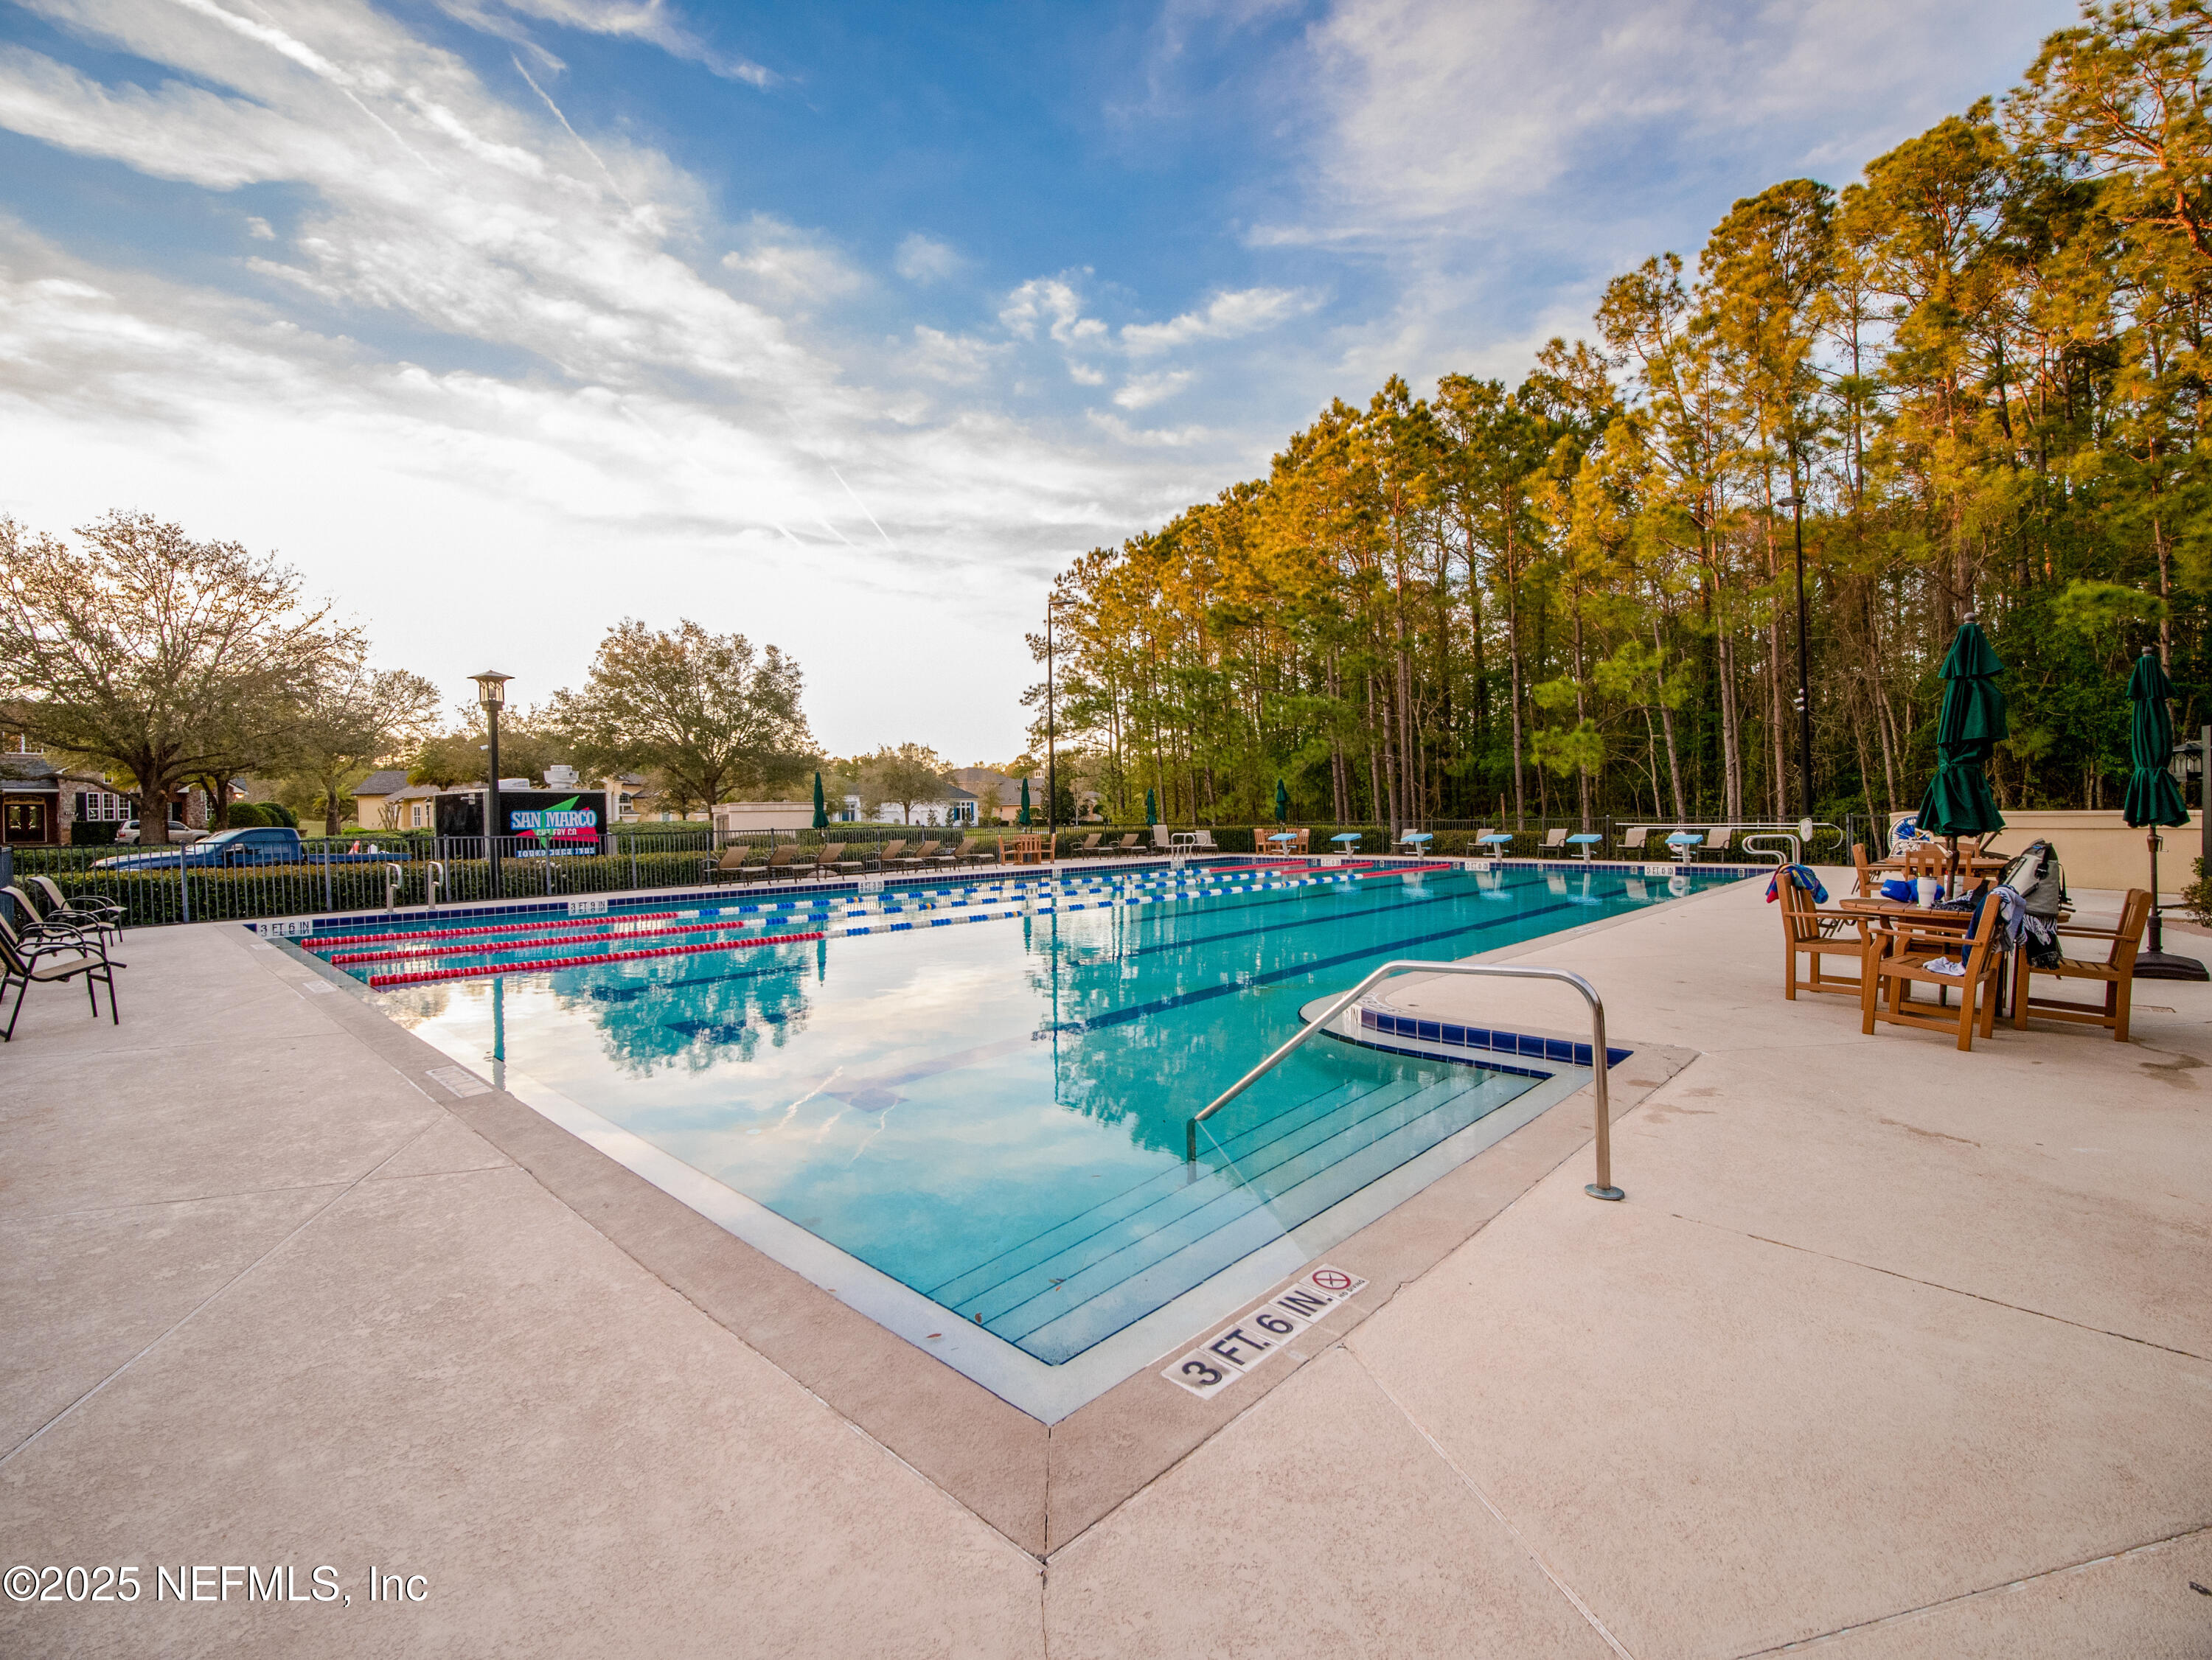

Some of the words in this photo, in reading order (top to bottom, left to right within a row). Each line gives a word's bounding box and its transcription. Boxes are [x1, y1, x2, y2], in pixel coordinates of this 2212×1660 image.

[512, 812, 541, 828] SAN
[546, 811, 596, 827] MARCO
[299, 921, 309, 930] IN
[1181, 1360, 1222, 1386] 3
[1209, 1328, 1272, 1366] FT.
[1256, 1314, 1294, 1334] 6
[1276, 1290, 1333, 1318] IN.
